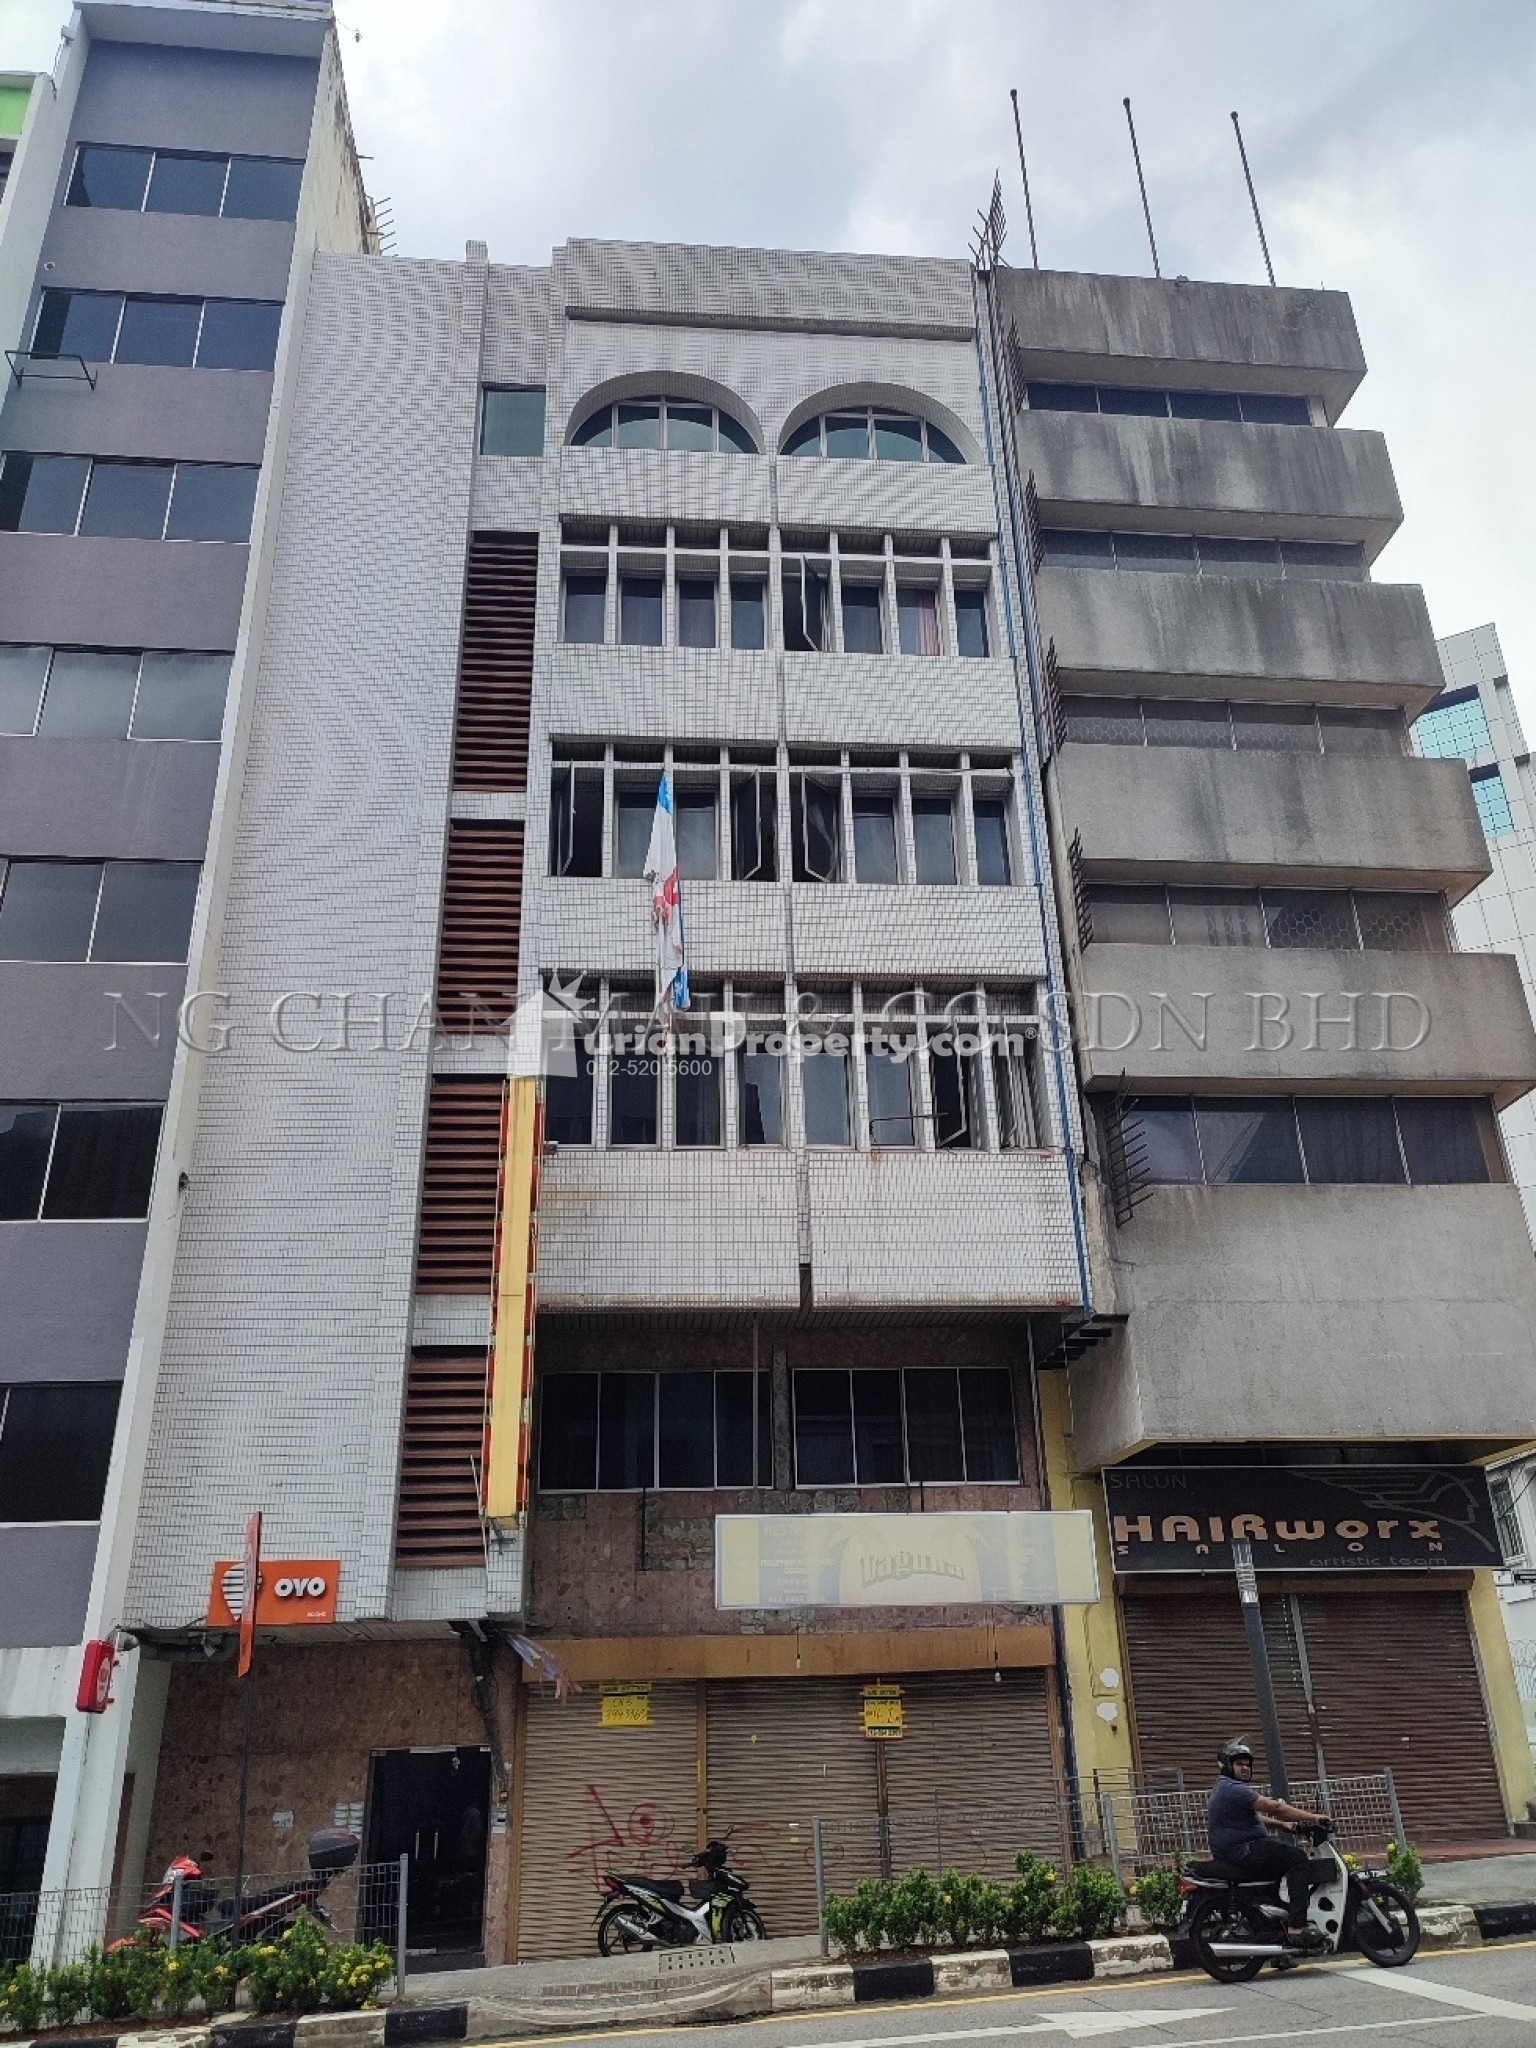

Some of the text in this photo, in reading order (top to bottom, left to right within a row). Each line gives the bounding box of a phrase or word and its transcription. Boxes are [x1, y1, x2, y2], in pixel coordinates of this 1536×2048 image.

[1109, 1474, 1188, 1490] SALUN
[1114, 1514, 1442, 1542] HAIRworx
[1309, 1555, 1448, 1567] artistic team
[275, 1577, 325, 1597] OYO
